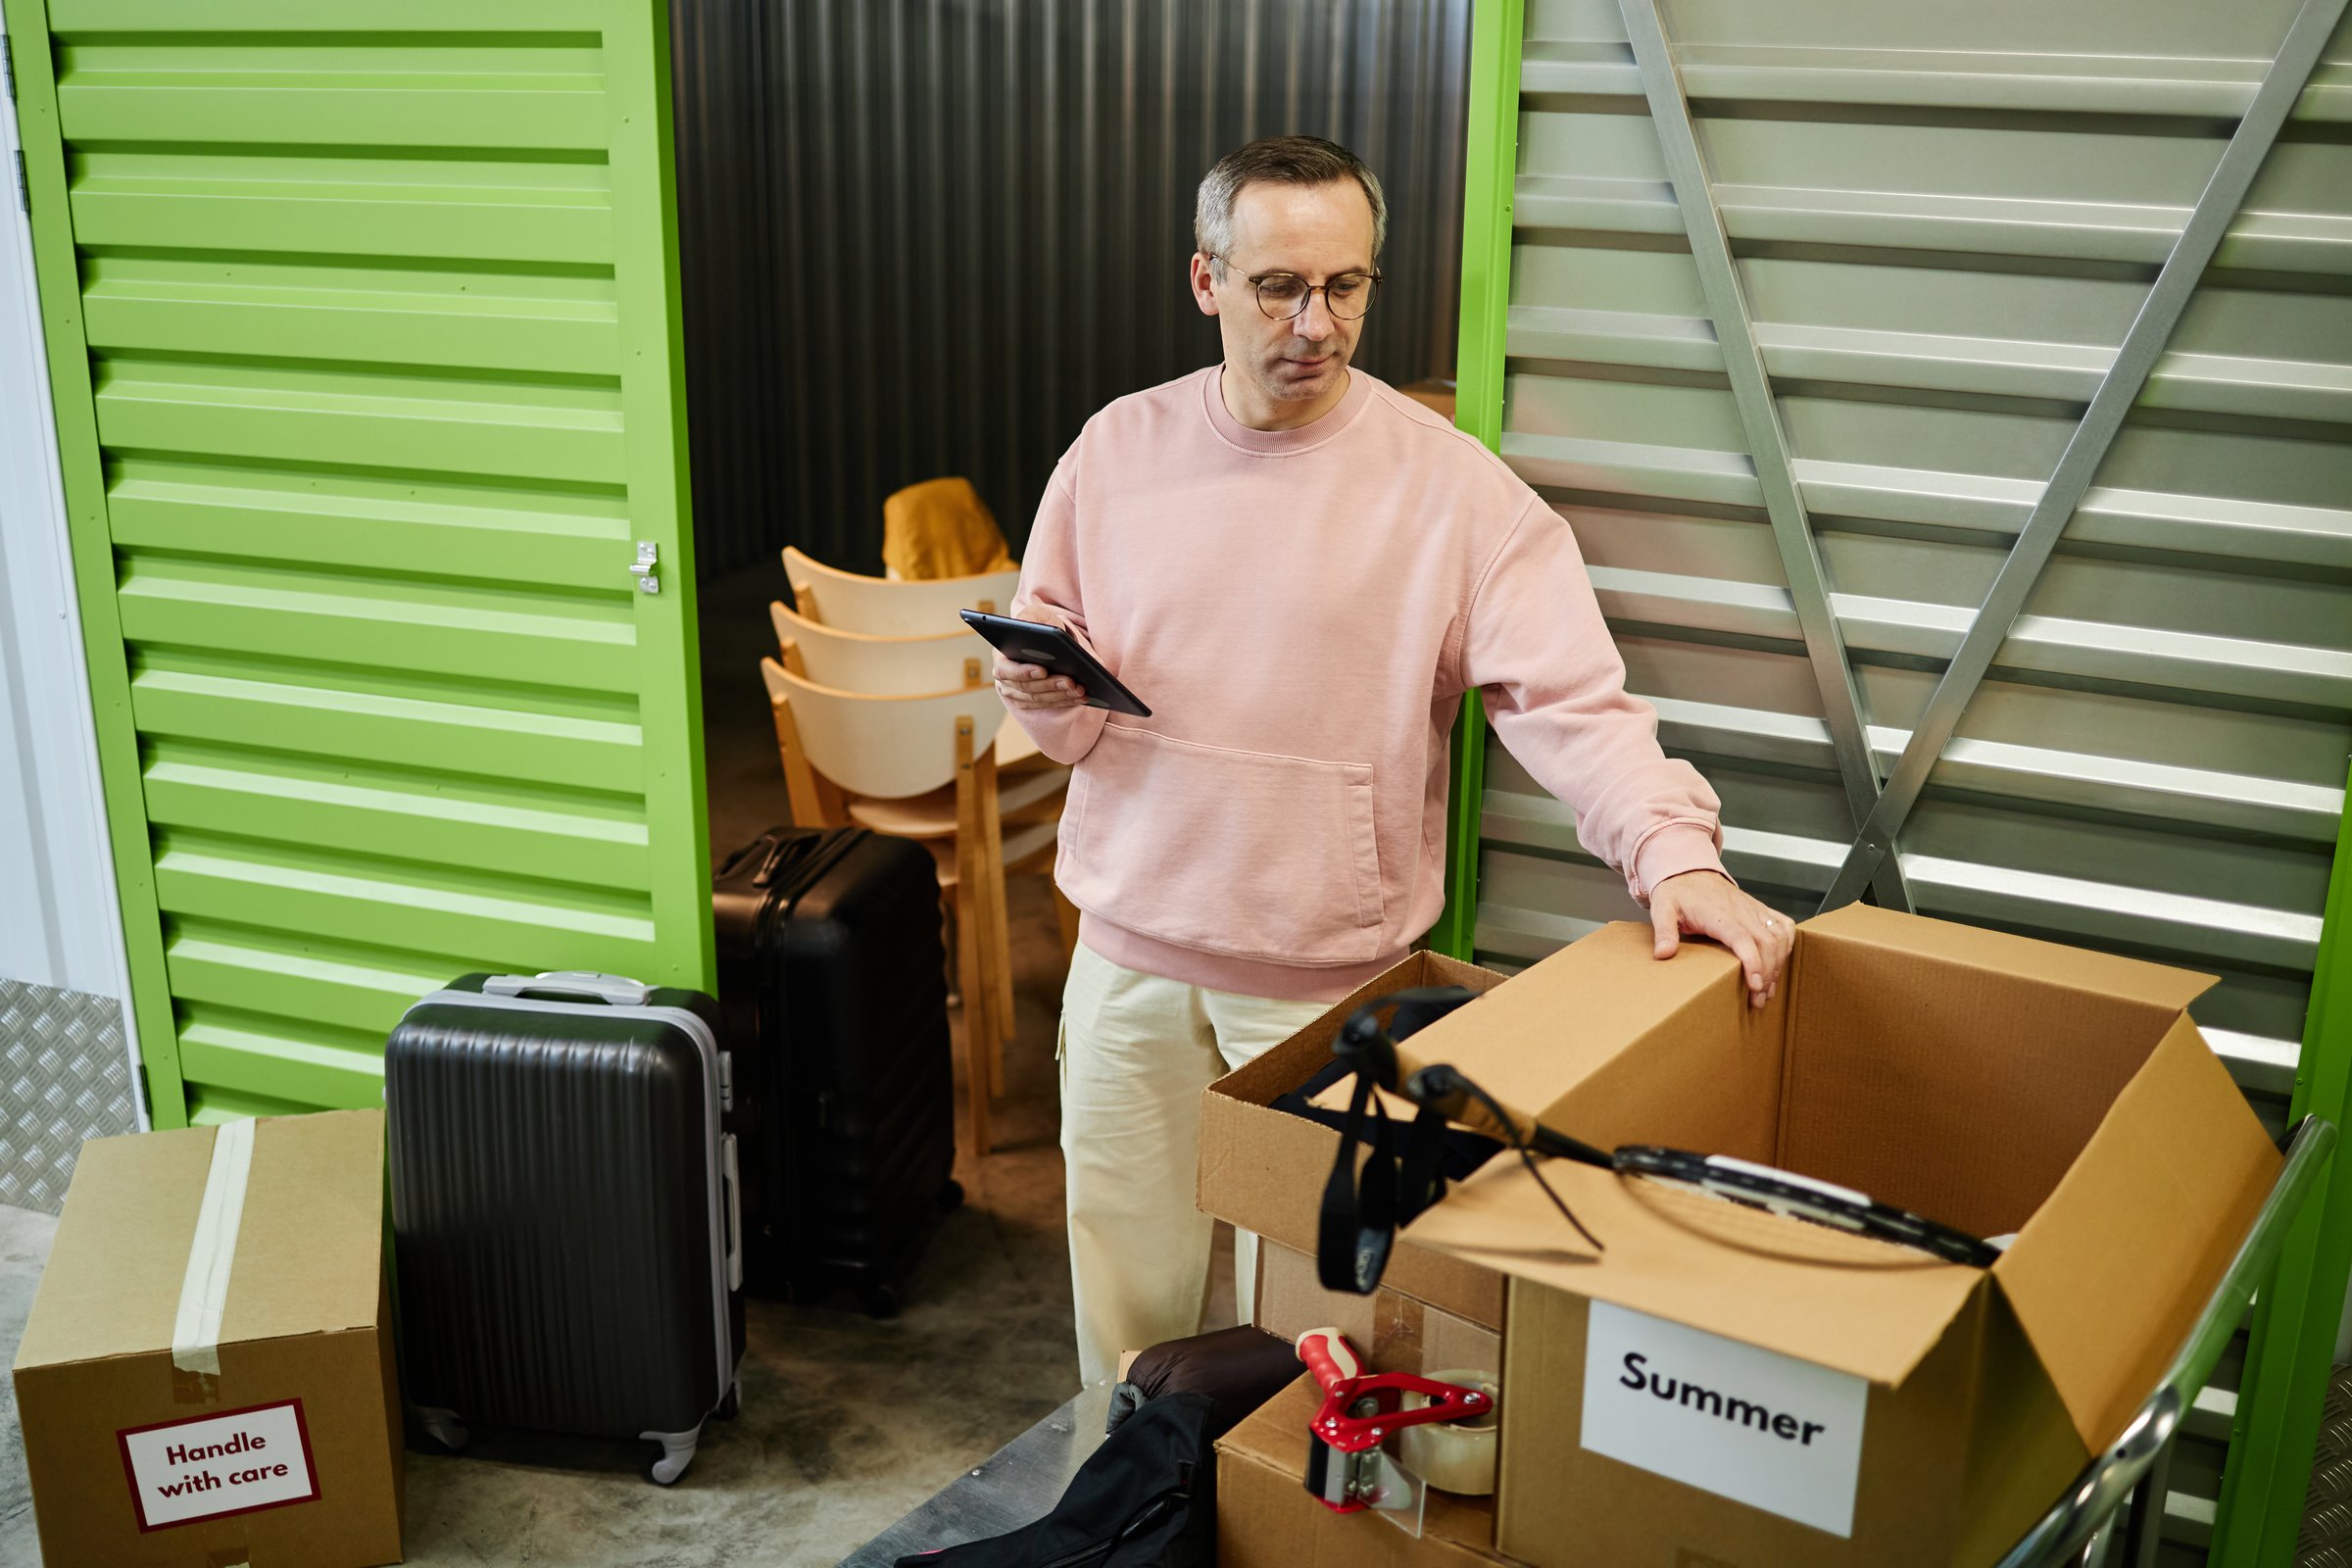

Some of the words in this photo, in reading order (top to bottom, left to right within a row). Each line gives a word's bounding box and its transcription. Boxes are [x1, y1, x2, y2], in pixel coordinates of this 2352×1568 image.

[1618, 1350, 1827, 1447] Summer
[165, 1431, 268, 1467] Handle
[156, 1469, 222, 1499] with
[228, 1462, 290, 1487] care
